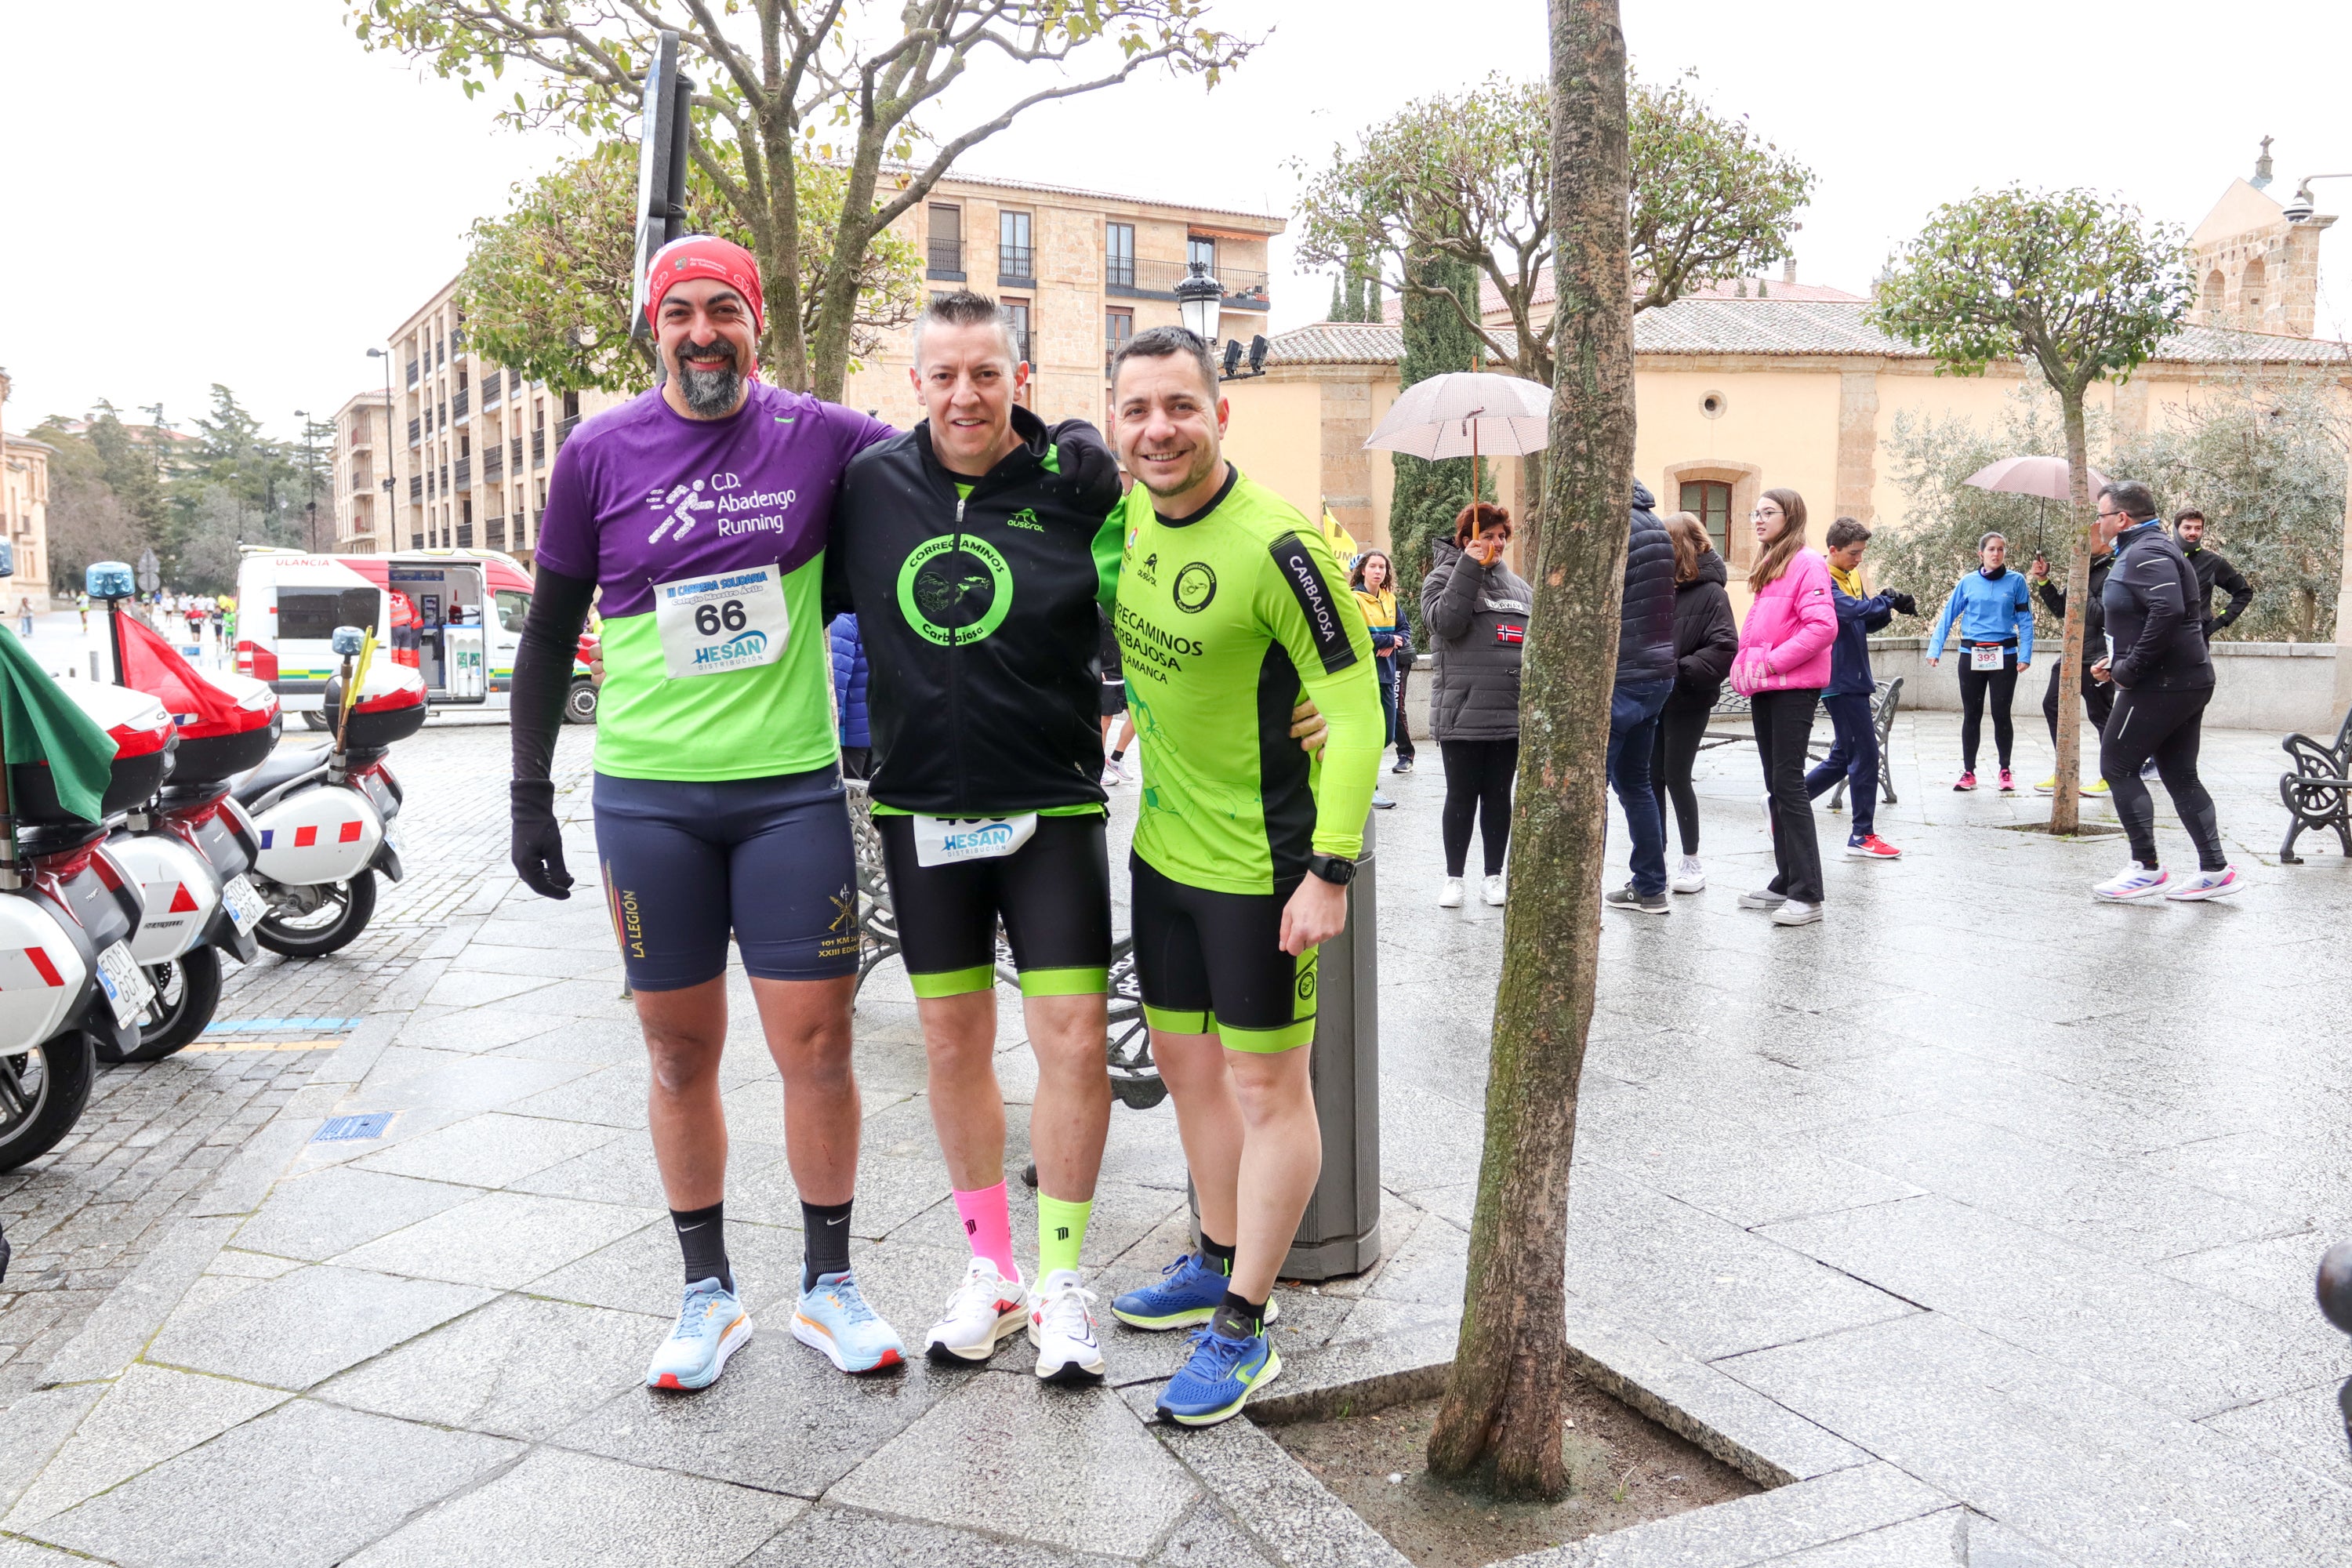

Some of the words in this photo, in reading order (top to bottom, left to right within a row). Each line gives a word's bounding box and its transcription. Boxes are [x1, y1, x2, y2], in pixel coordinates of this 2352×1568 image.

[711, 473, 742, 492] C.D.
[717, 489, 796, 514] Abadengo
[718, 514, 784, 537] Running
[666, 587, 677, 598] III
[677, 580, 719, 597] CARRERA
[720, 572, 768, 589] SOLIDARIA
[1181, 564, 1215, 583] CORRECAMINOS
[671, 596, 704, 606] Colegio
[705, 590, 739, 601] Maestro
[740, 584, 764, 596] Ávila
[1289, 555, 1335, 642] CARBAJOSA
[695, 600, 746, 636] 66
[694, 638, 761, 664] HESAN
[699, 655, 764, 670] DISTRIBUCIÓN
[944, 831, 1006, 851] HESAN
[947, 844, 1007, 858] DISTRIBUCIÓN
[224, 876, 251, 907] 5032
[239, 898, 260, 925] GCF
[622, 890, 641, 938] LEGIÓN
[631, 942, 645, 958] LA
[100, 946, 131, 982] 5011
[118, 970, 142, 1004] GCF
